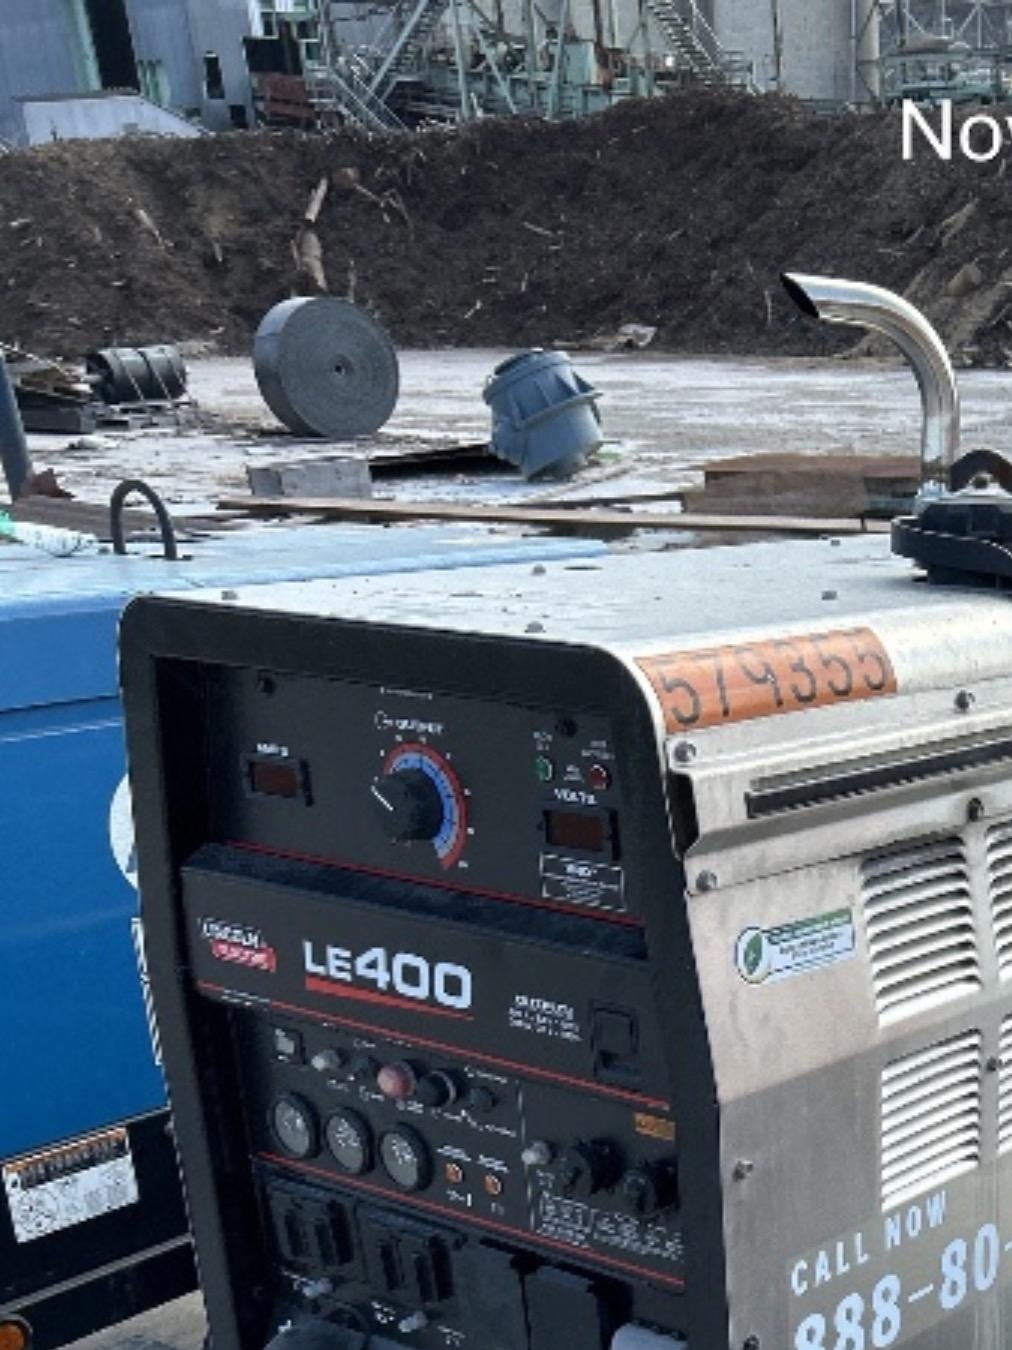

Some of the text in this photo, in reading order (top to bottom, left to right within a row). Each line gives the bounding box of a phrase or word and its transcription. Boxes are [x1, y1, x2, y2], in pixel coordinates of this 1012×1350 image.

[303, 939, 472, 1008] LE400
[791, 1191, 947, 1296] CALL NOW
